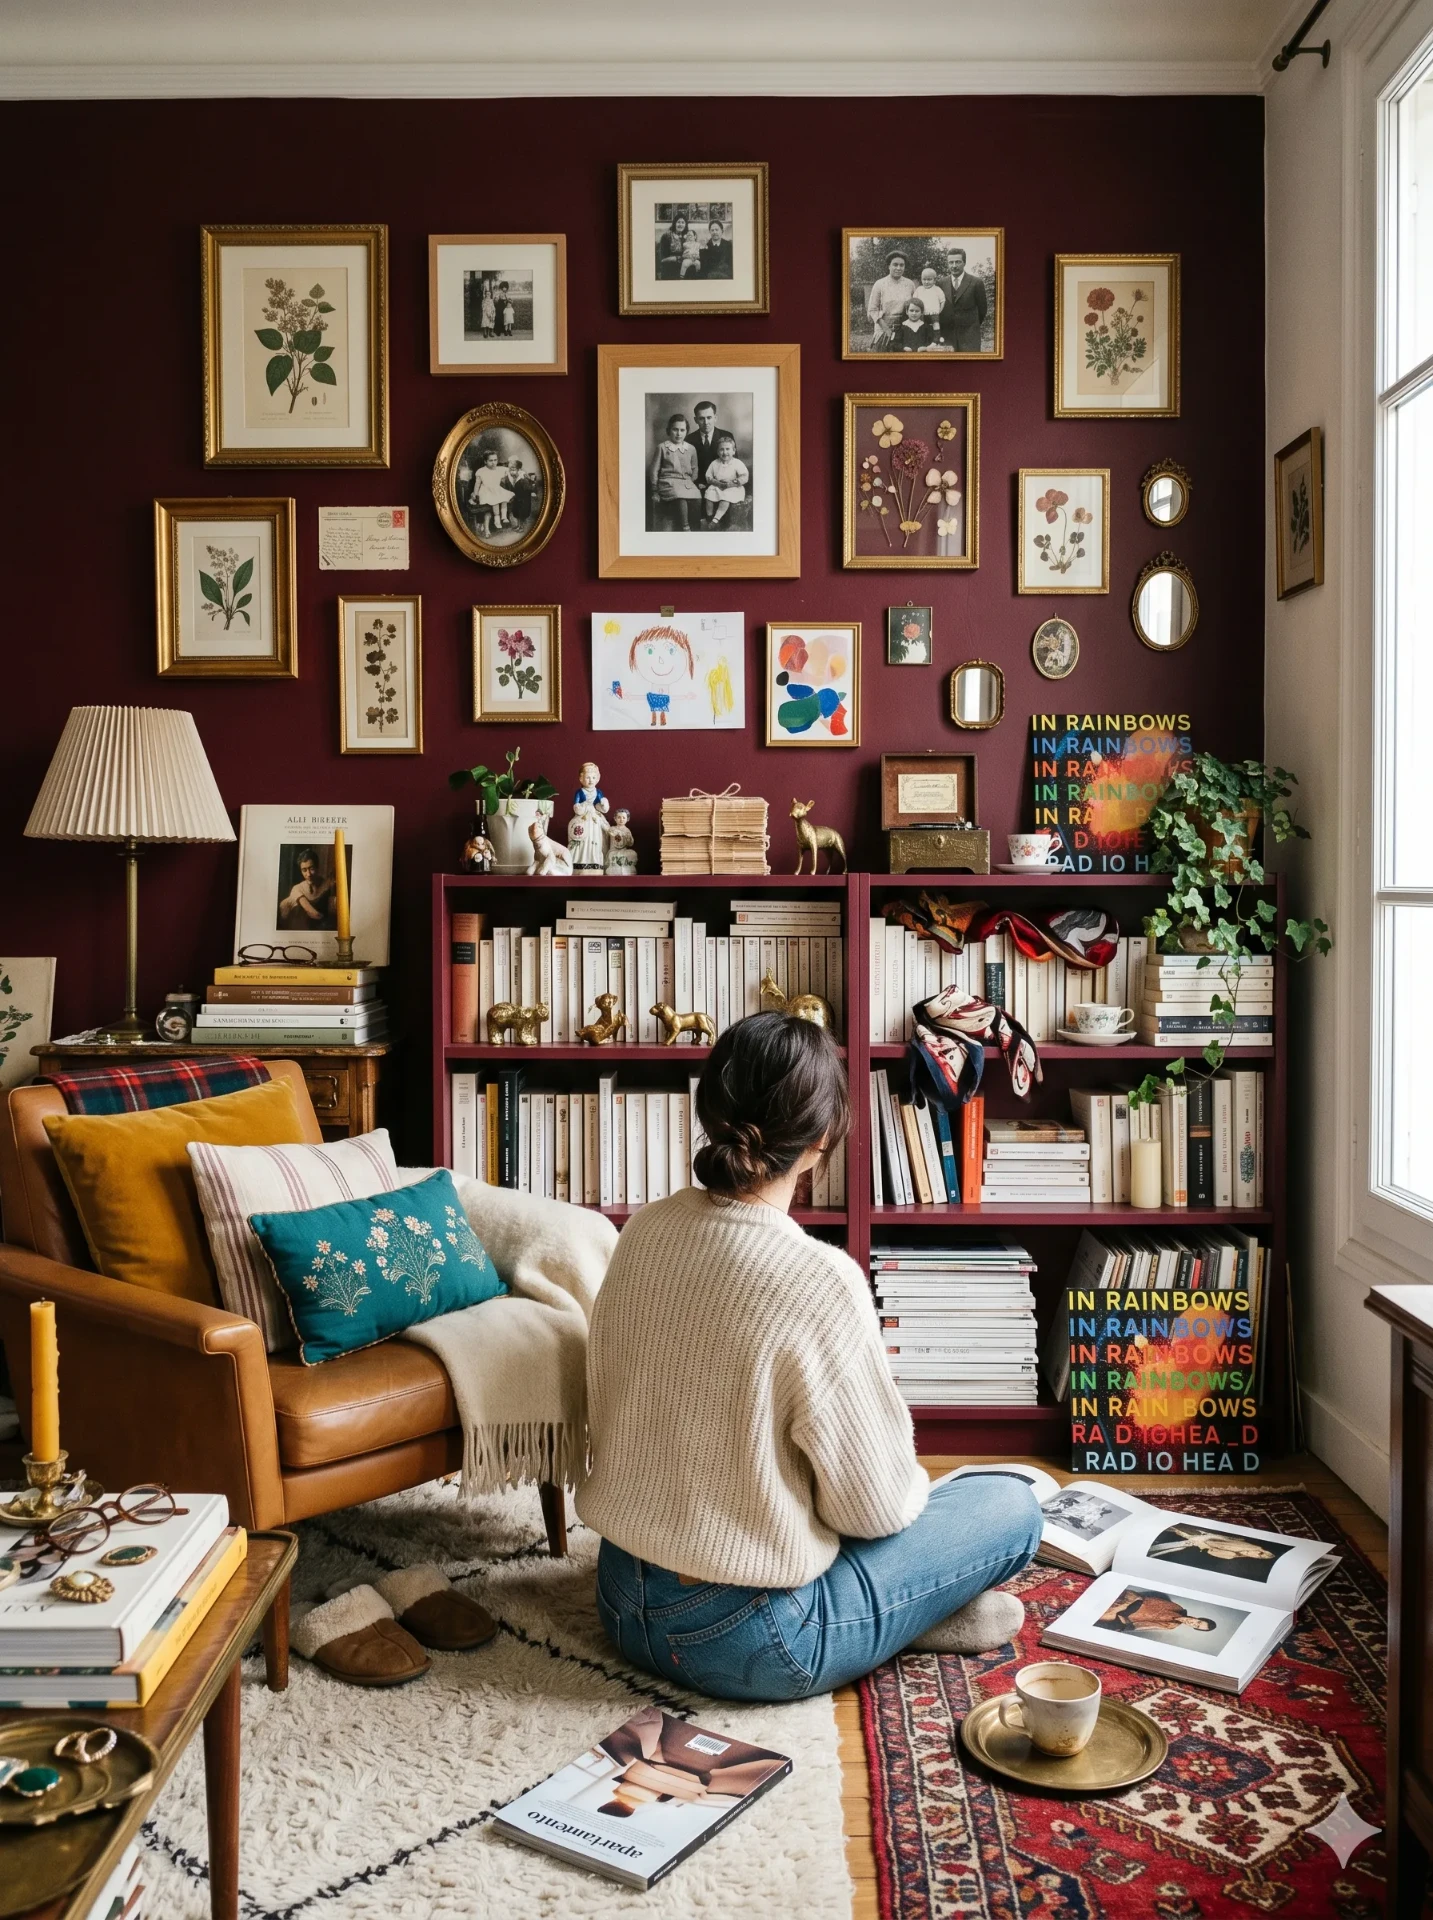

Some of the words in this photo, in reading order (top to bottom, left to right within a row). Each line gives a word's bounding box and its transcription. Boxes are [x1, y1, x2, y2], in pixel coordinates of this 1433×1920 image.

[1032, 714, 1057, 731] IN
[1066, 714, 1191, 731] RAINBOWS
[1033, 737, 1057, 754] IN
[1066, 737, 1193, 754] RAINBOWS
[1034, 760, 1057, 778] IN
[1034, 783, 1058, 801] IN
[1035, 807, 1059, 825] IN
[1068, 1291, 1095, 1311] IN
[1106, 1291, 1250, 1311] RAINBOWS
[1069, 1318, 1096, 1337] IN
[1107, 1318, 1251, 1338] RAINBOWS
[1070, 1344, 1097, 1364] IN
[1107, 1344, 1253, 1365] RAINBOWS
[1071, 1370, 1097, 1390] IN
[1072, 1397, 1098, 1417] IN
